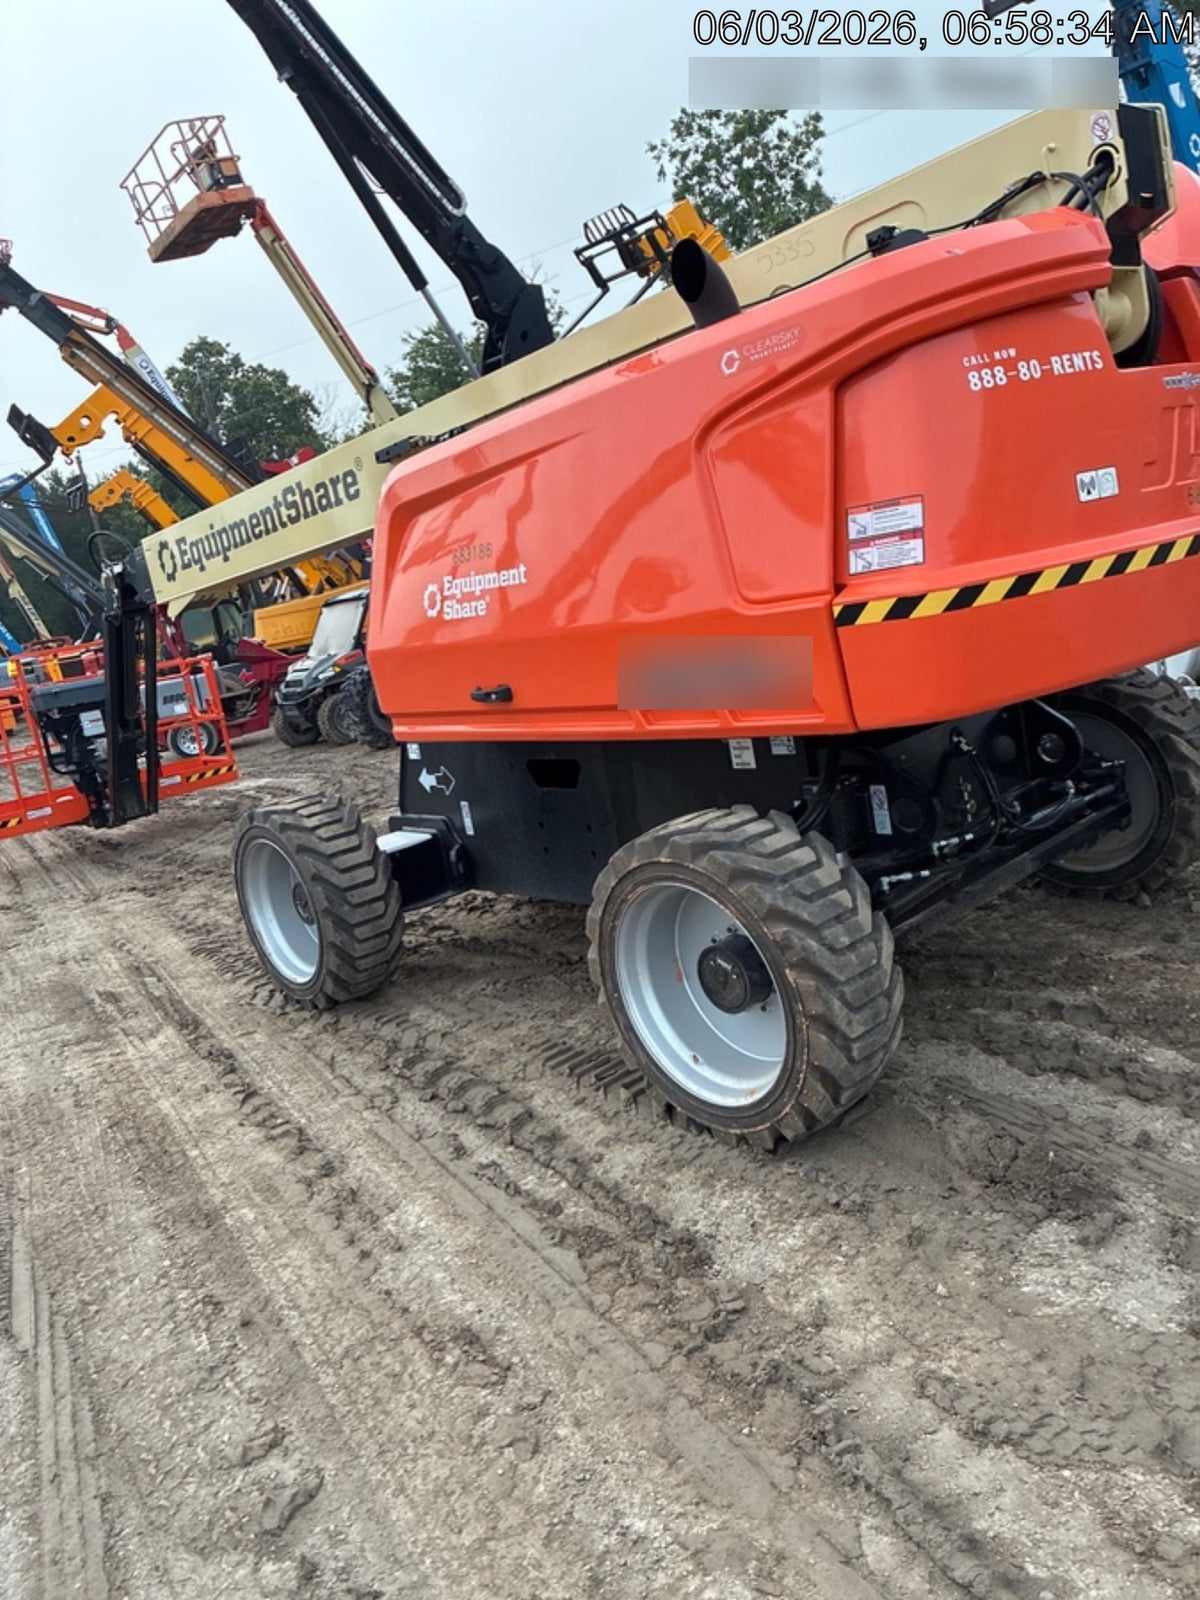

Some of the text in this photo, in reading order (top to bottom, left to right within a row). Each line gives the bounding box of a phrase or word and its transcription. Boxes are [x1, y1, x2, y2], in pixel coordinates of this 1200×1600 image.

[742, 327, 801, 357] CLEARSKY
[962, 348, 1017, 367] CALL NOW
[967, 350, 1104, 391] 888-80-RENTS
[442, 563, 528, 599] Equipment
